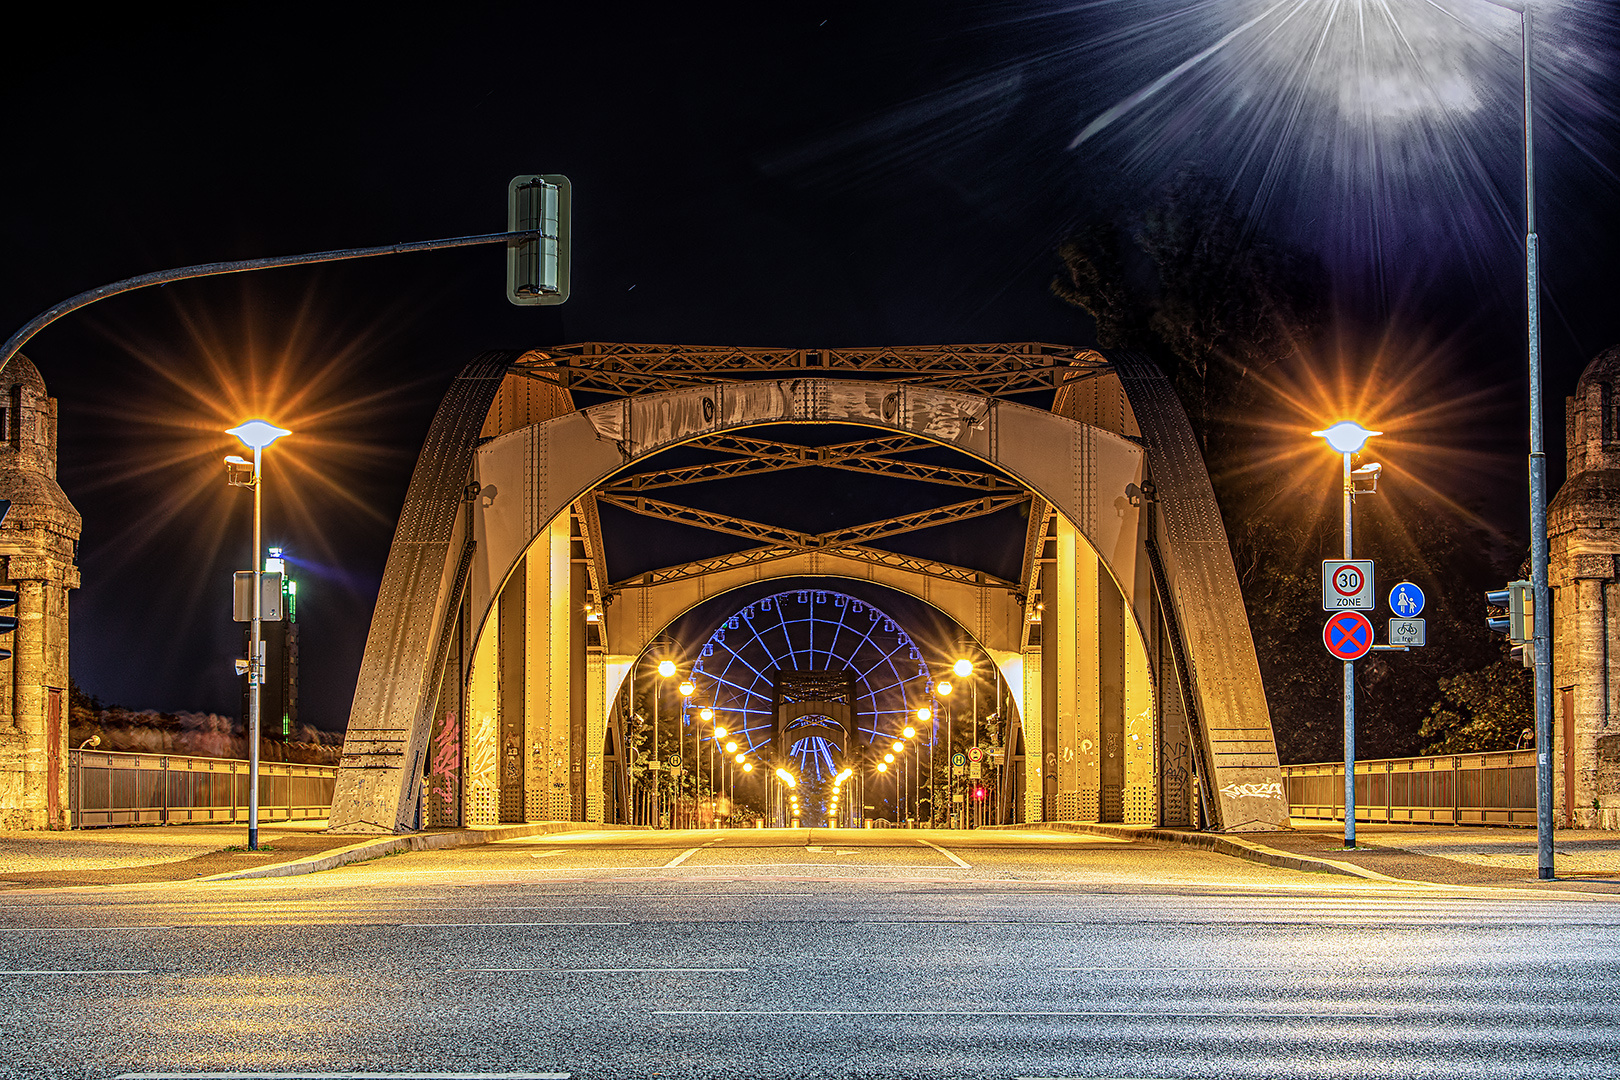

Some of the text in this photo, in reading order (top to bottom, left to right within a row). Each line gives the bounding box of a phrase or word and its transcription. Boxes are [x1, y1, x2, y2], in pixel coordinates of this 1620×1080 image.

[1338, 573, 1358, 588] 30
[1336, 598, 1361, 607] ZONE
[956, 756, 962, 764] H
